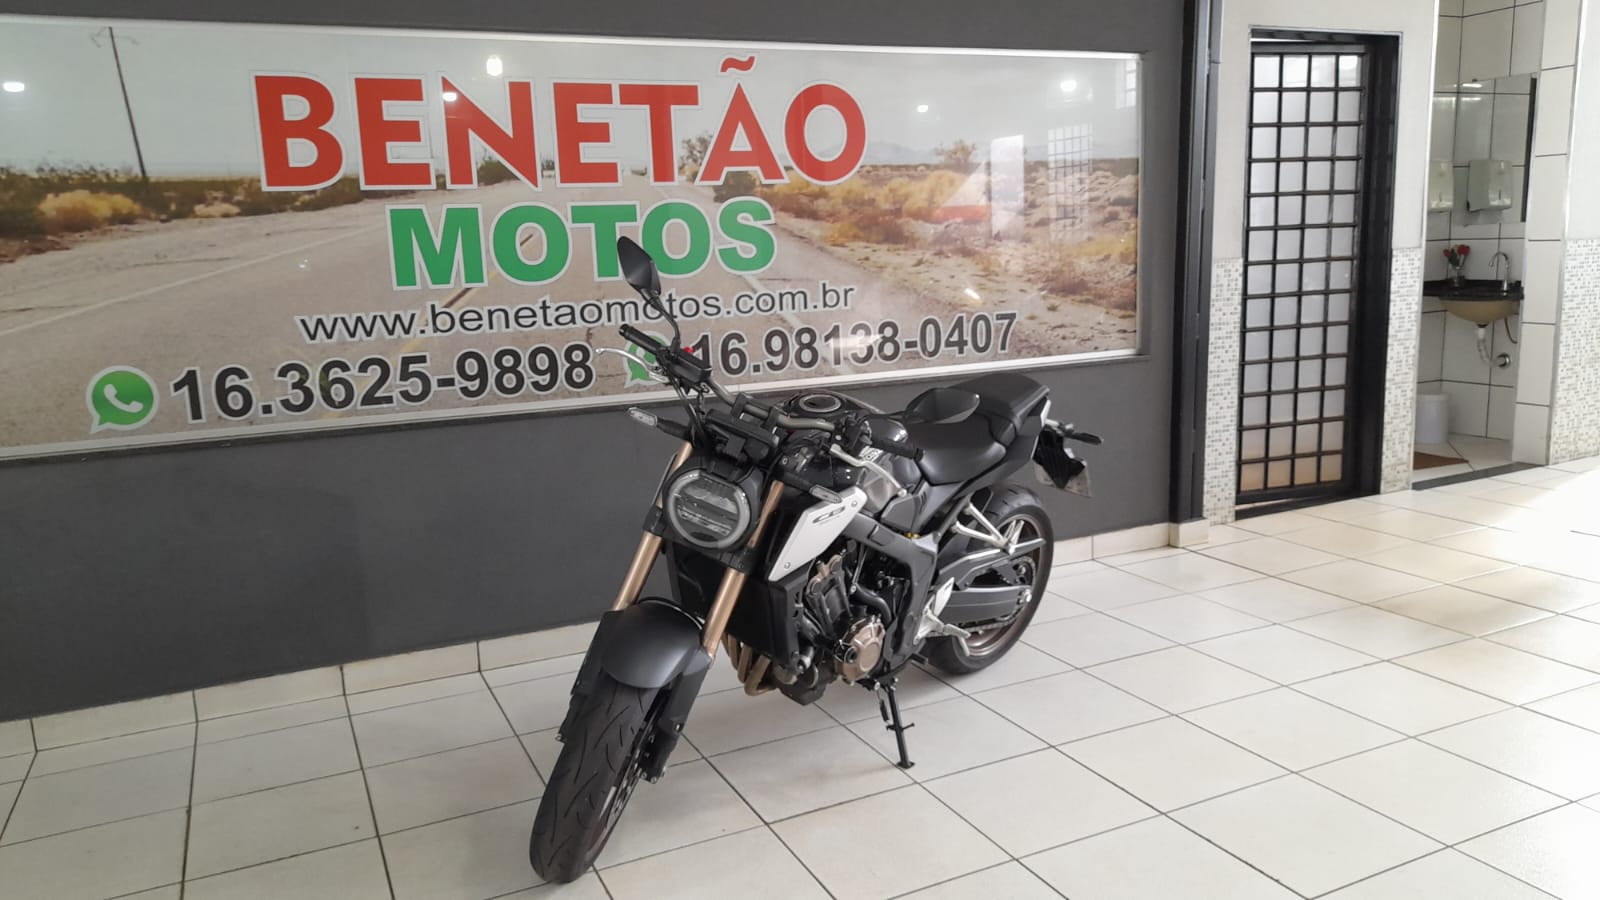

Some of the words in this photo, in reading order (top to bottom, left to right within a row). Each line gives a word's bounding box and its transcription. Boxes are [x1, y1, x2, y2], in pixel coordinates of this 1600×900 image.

[254, 56, 867, 191] BENETÃO
[389, 199, 776, 287] MOTOS
[301, 282, 853, 341] www.benetaomotos.com.br
[693, 313, 1017, 375] 16.98138-0407
[172, 344, 594, 422] 16.3625-9898
